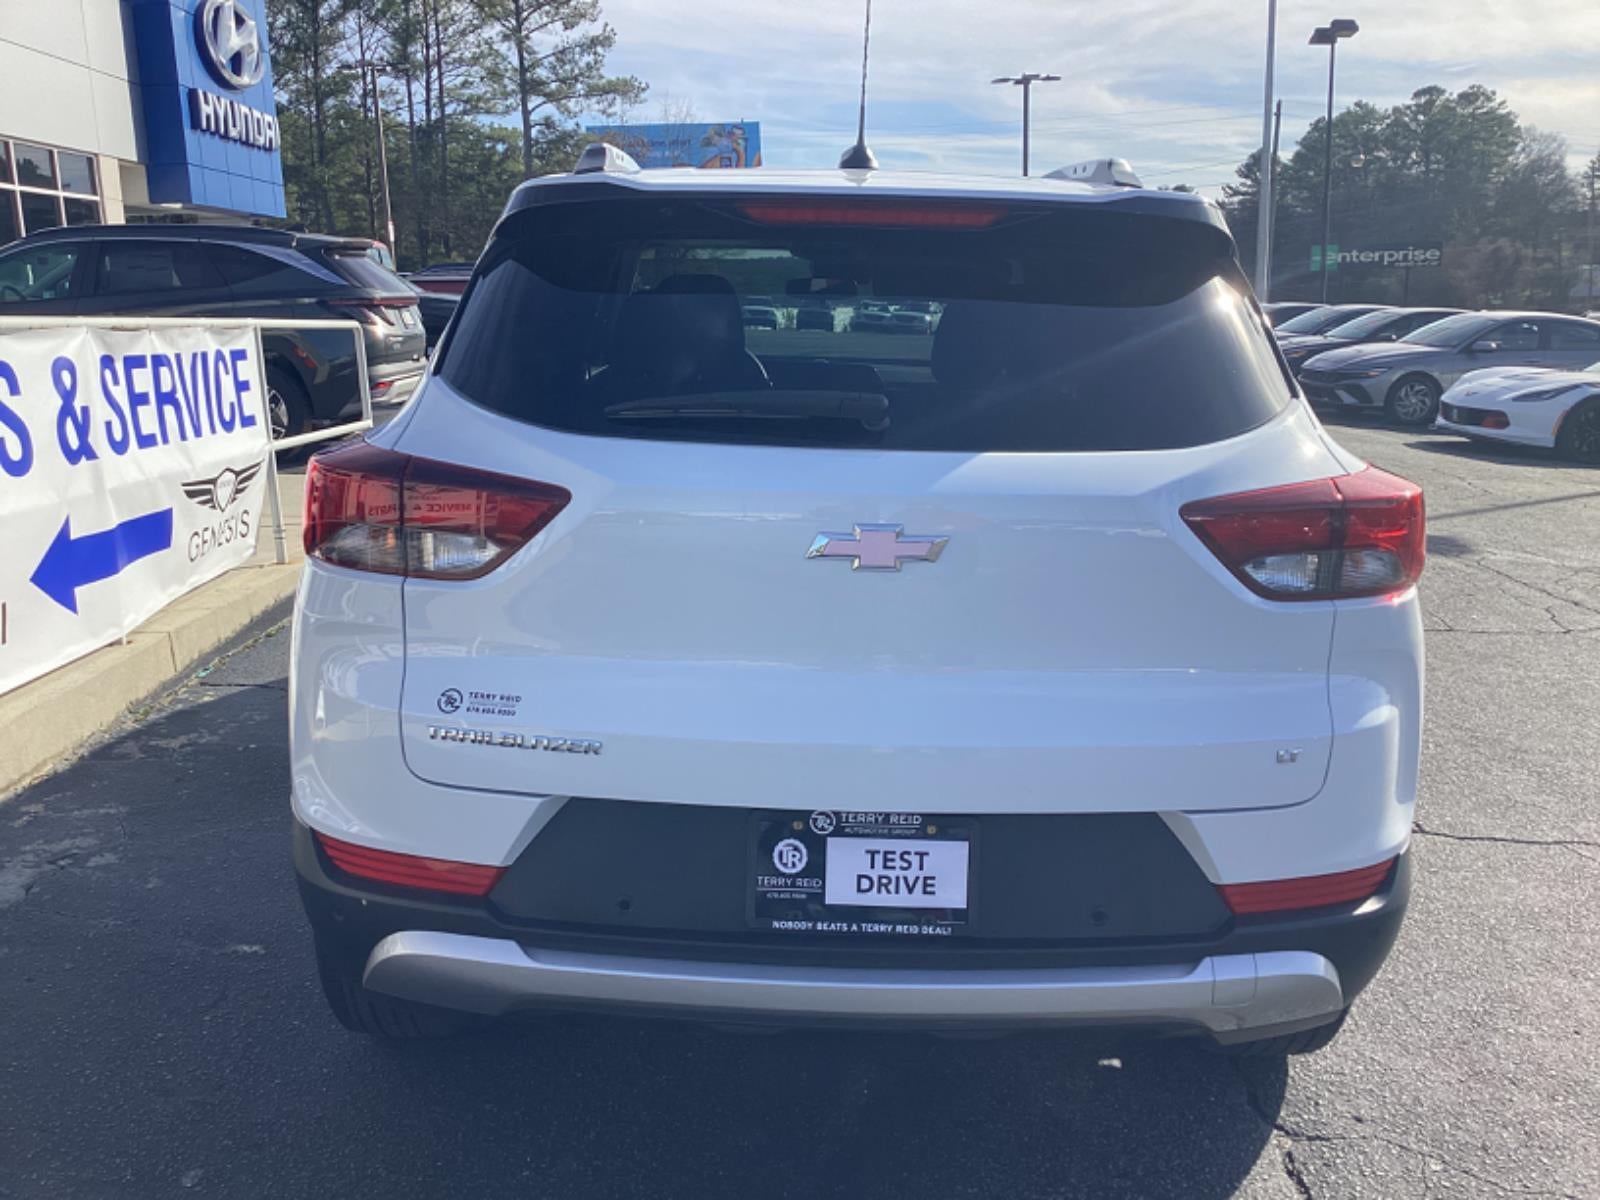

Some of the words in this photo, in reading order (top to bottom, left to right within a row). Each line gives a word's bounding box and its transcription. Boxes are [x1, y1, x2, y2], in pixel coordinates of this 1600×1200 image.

[1318, 246, 1441, 266] enterprise
[50, 355, 99, 466] &
[100, 348, 257, 456] SERVICE
[188, 509, 250, 563] GENESIS
[427, 725, 603, 755] TRAILBLAZER
[841, 812, 885, 825] TERRY
[888, 814, 923, 826] REID
[865, 849, 930, 872] TEST
[757, 875, 793, 888] TERRY
[795, 877, 823, 889] REID
[856, 873, 936, 896] DRIVE
[771, 919, 813, 931] NOBODY
[815, 921, 849, 933] BEATS
[850, 923, 859, 933] A
[860, 923, 894, 934] TERRY
[895, 924, 919, 935] REID
